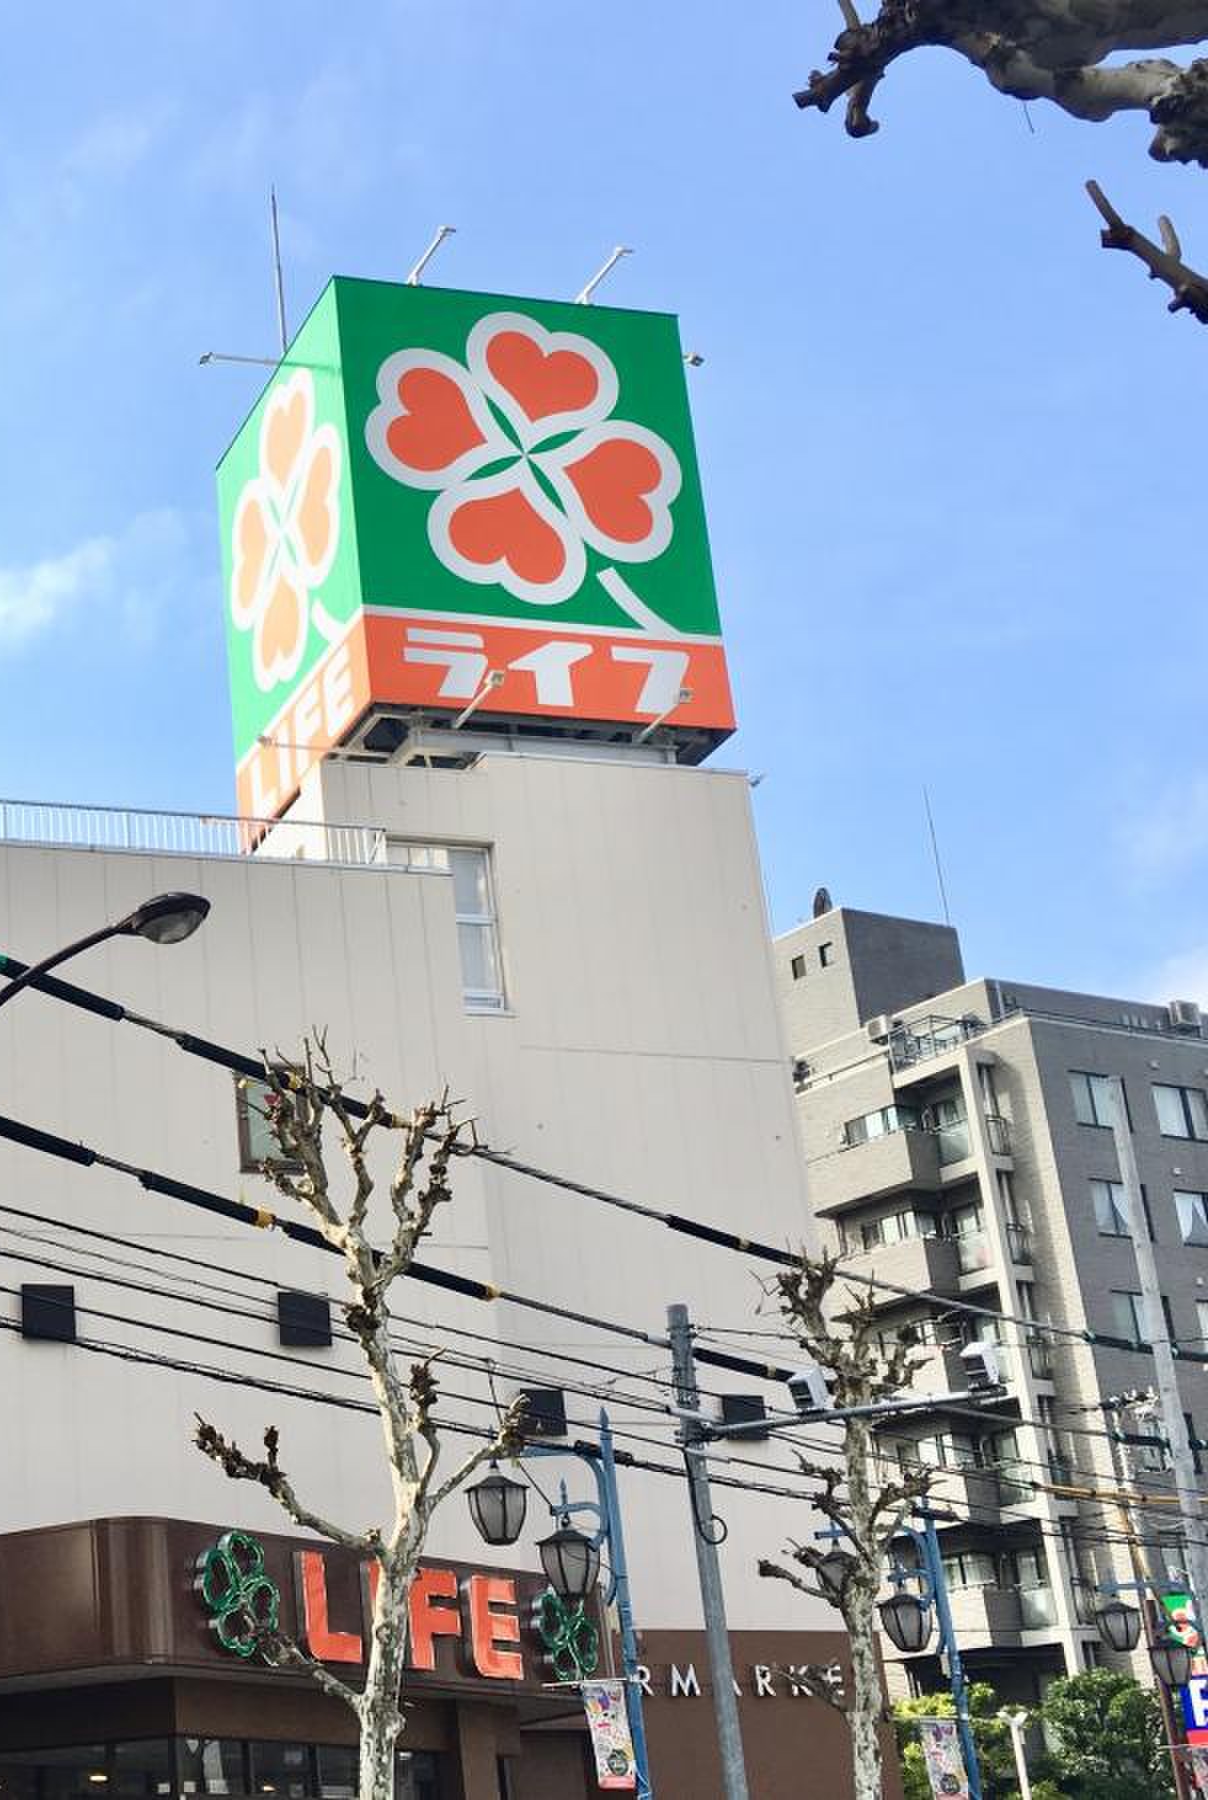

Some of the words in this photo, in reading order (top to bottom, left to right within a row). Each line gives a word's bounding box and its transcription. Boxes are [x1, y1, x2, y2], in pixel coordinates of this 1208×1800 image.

[403, 627, 689, 715] ライフ
[251, 641, 354, 821] LIFE
[298, 1551, 522, 1680] LFE
[634, 1664, 845, 1696] RMRKE
